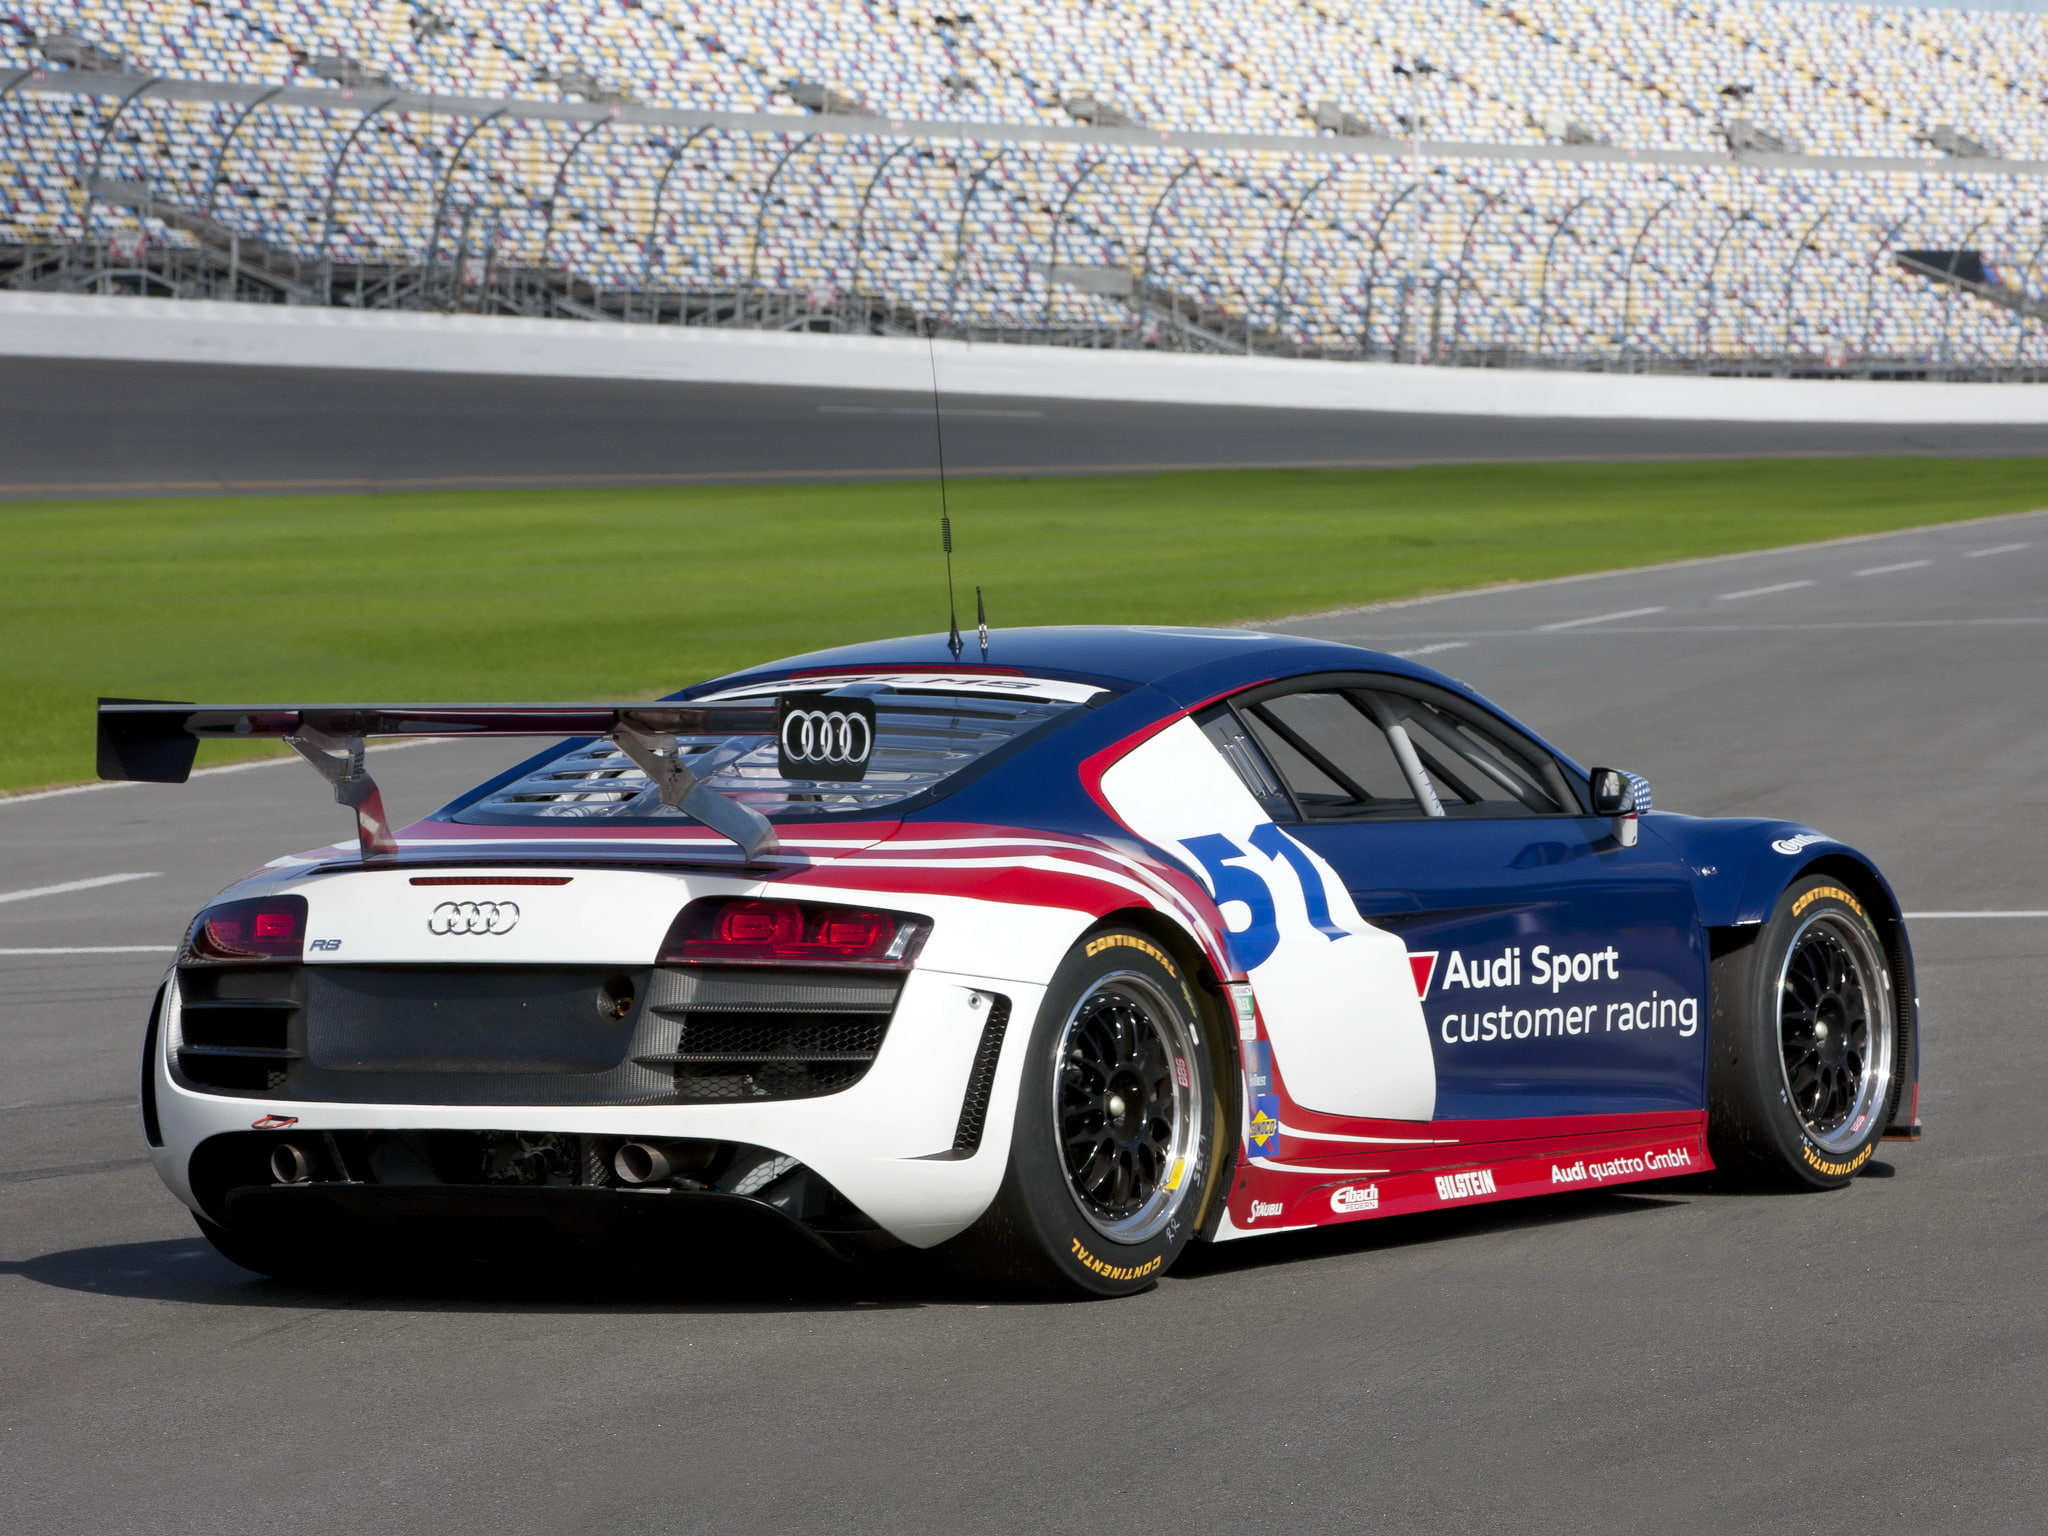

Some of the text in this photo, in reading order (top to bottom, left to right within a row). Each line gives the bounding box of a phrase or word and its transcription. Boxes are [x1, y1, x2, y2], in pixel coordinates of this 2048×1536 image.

[873, 676, 1041, 690] LMS
[1176, 822, 1352, 973] 51
[1791, 886, 1863, 917] CONTINENTAL
[309, 939, 342, 951] R8
[1085, 934, 1177, 979] CONTINENTAL
[1442, 945, 1619, 994] Audi Sport
[1441, 991, 1698, 1043] customer racing
[1175, 1057, 1189, 1087] BBS
[1250, 1121, 1275, 1135] SUNOCO
[1551, 1147, 1691, 1184] Audi quattro GmbH
[1803, 1143, 1872, 1175] CONTINENTAL
[1331, 1184, 1379, 1213] Eibach
[1434, 1169, 1496, 1200] BILSTEIN
[1345, 1201, 1375, 1210] FEDERN
[1071, 1237, 1163, 1280] CONTINENTAL
